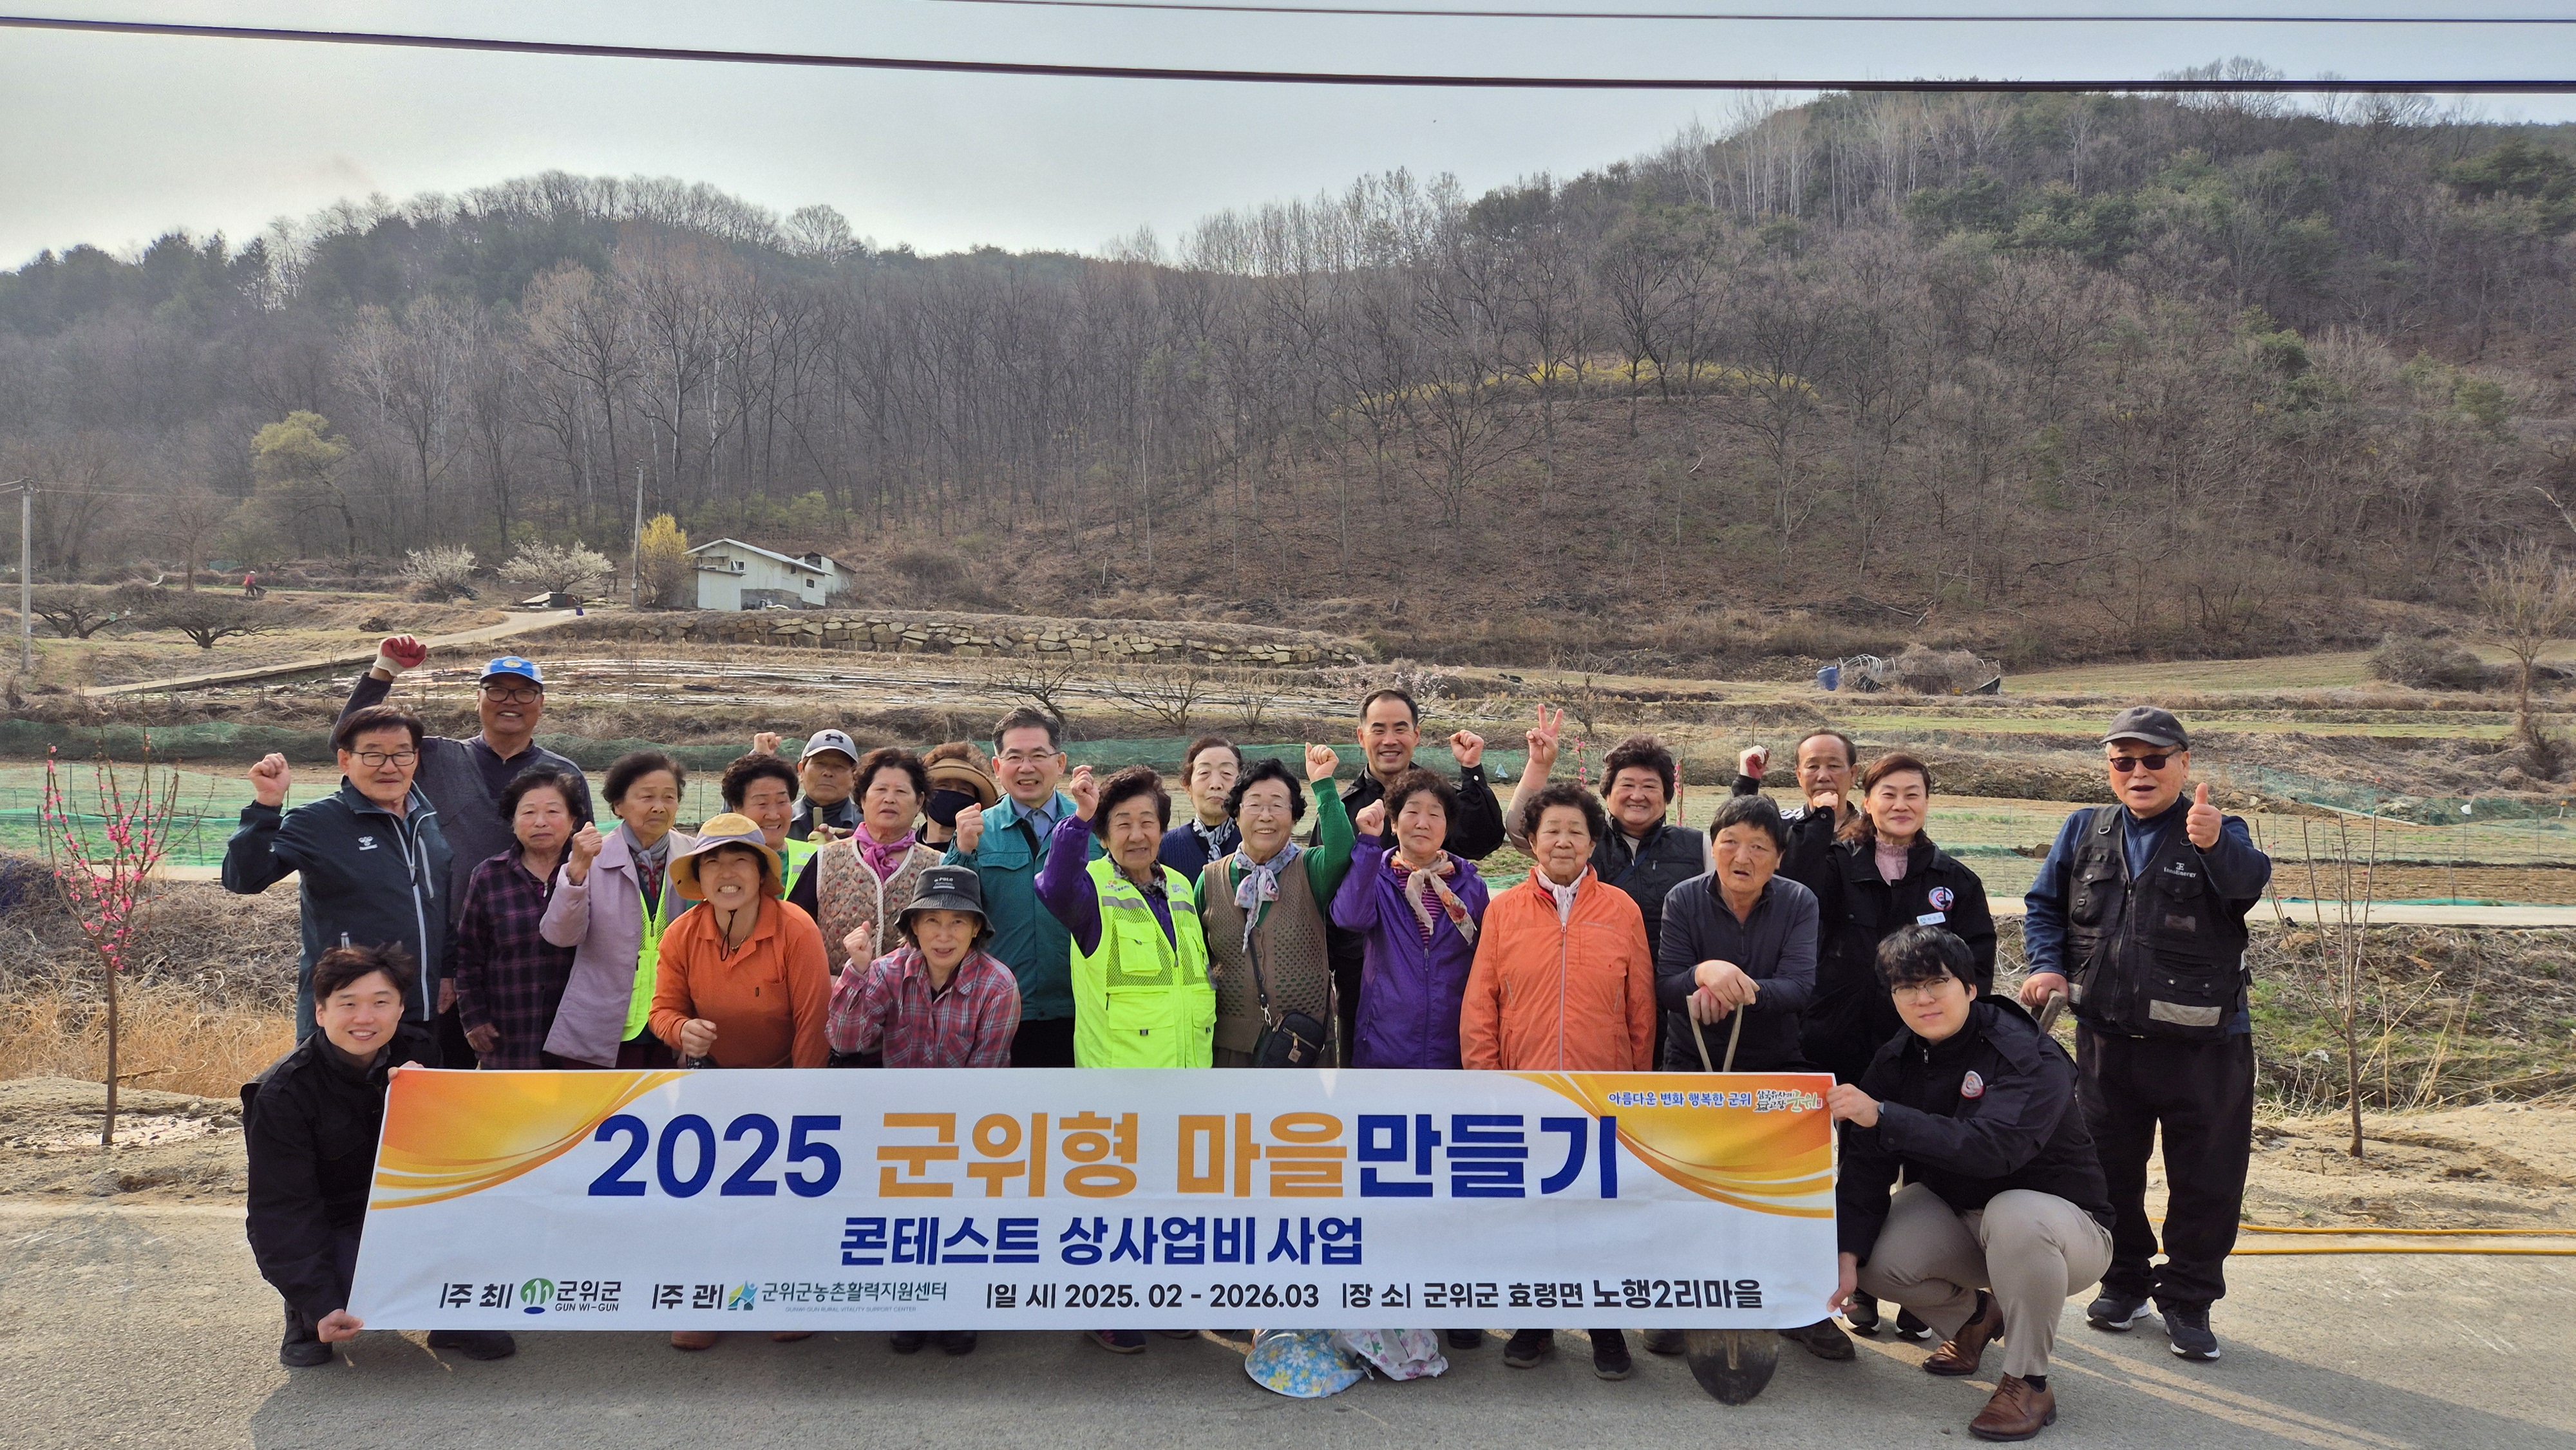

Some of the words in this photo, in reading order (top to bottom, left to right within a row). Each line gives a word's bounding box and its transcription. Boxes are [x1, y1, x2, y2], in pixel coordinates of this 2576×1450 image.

[1608, 1091, 1657, 1106] 아름다운
[1660, 1092, 1685, 1106] 변화
[1688, 1092, 1725, 1107] 행복한
[1728, 1093, 1752, 1107] 군위
[1786, 1090, 1817, 1111] 군위
[587, 1114, 842, 1198] 2025
[877, 1111, 1138, 1198] 군위형
[841, 1217, 1039, 1265] 콘테스트
[1060, 1217, 1255, 1265] 상사업비
[1267, 1218, 1361, 1265] 사업
[557, 1281, 621, 1301] 군위군
[762, 1282, 946, 1302] 군위군농촌활력지원센터
[1065, 1285, 1139, 1308] 2025.
[1149, 1284, 1182, 1308] 02
[1210, 1285, 1318, 1308] 2026.03
[1424, 1283, 1499, 1308] 군위군
[1509, 1283, 1584, 1308] 효령면
[1593, 1279, 1762, 1308] 노행2리마을
